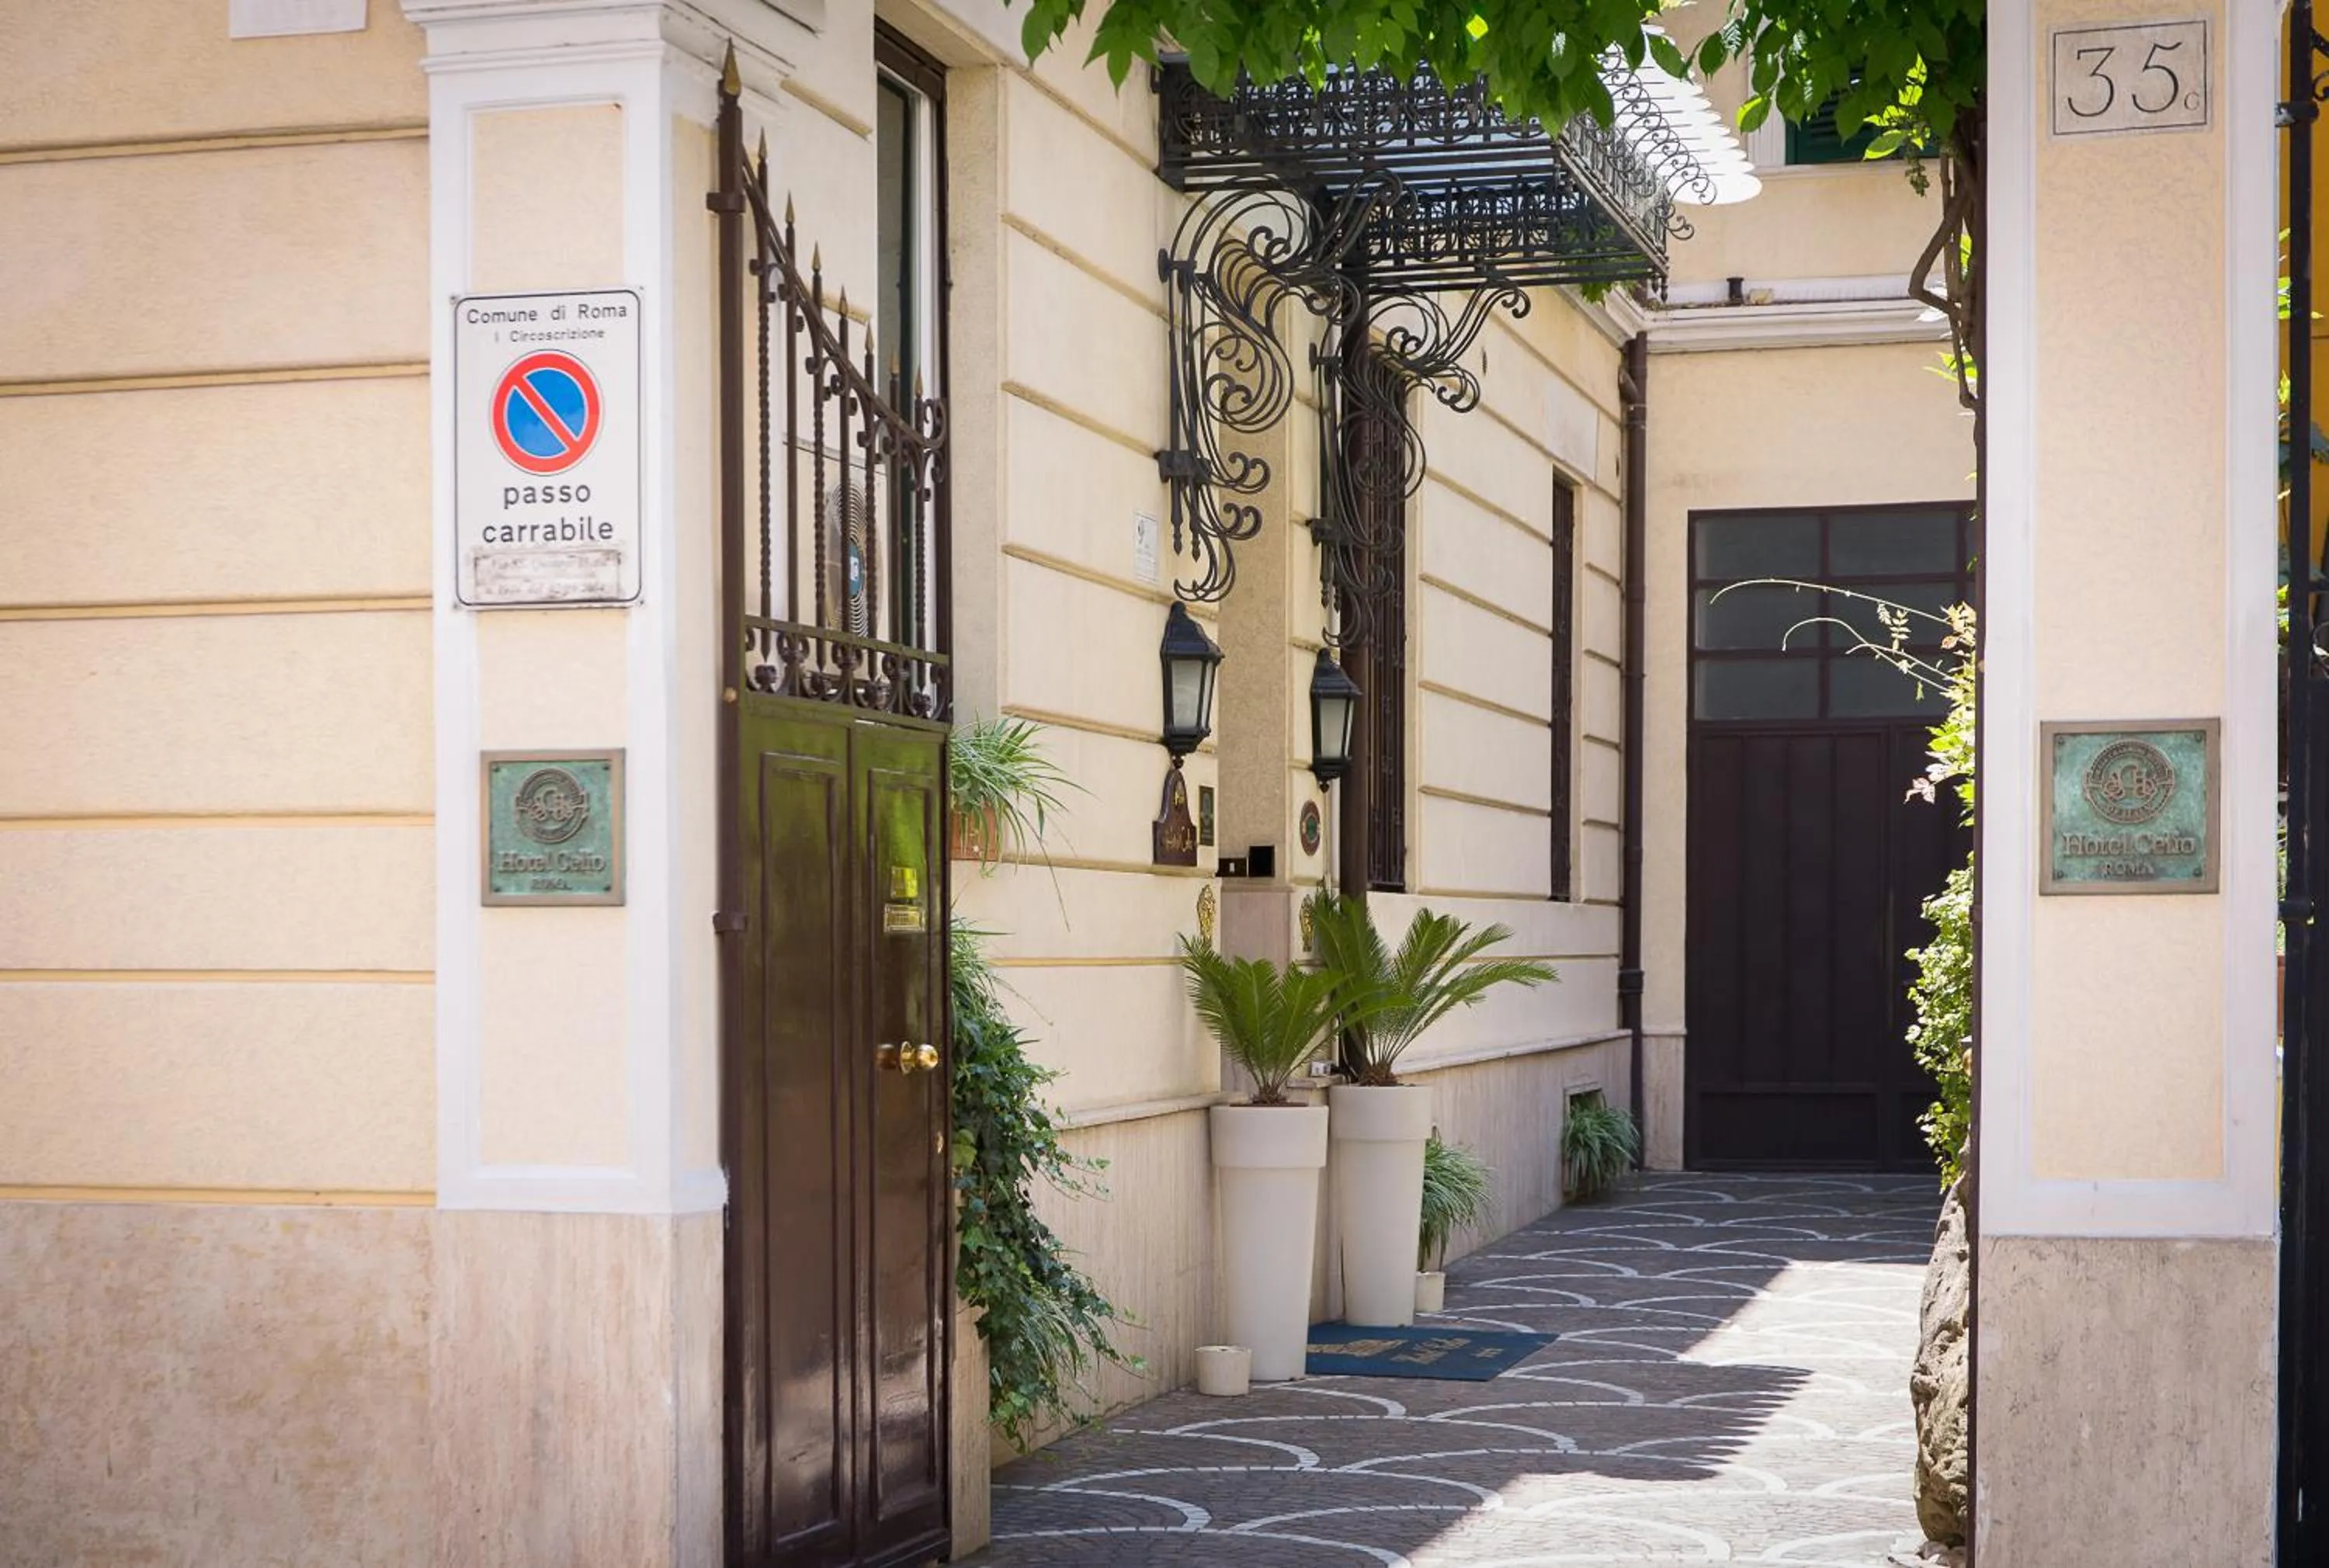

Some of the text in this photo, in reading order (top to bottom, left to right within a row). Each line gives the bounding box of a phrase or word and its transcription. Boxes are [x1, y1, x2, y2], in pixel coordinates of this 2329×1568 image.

[467, 304, 627, 324] Comune di Roma
[509, 329, 605, 342] Circoscrizione
[504, 484, 591, 509] passo
[482, 516, 612, 543] carrabile
[2062, 830, 2195, 856] Hotel Celio
